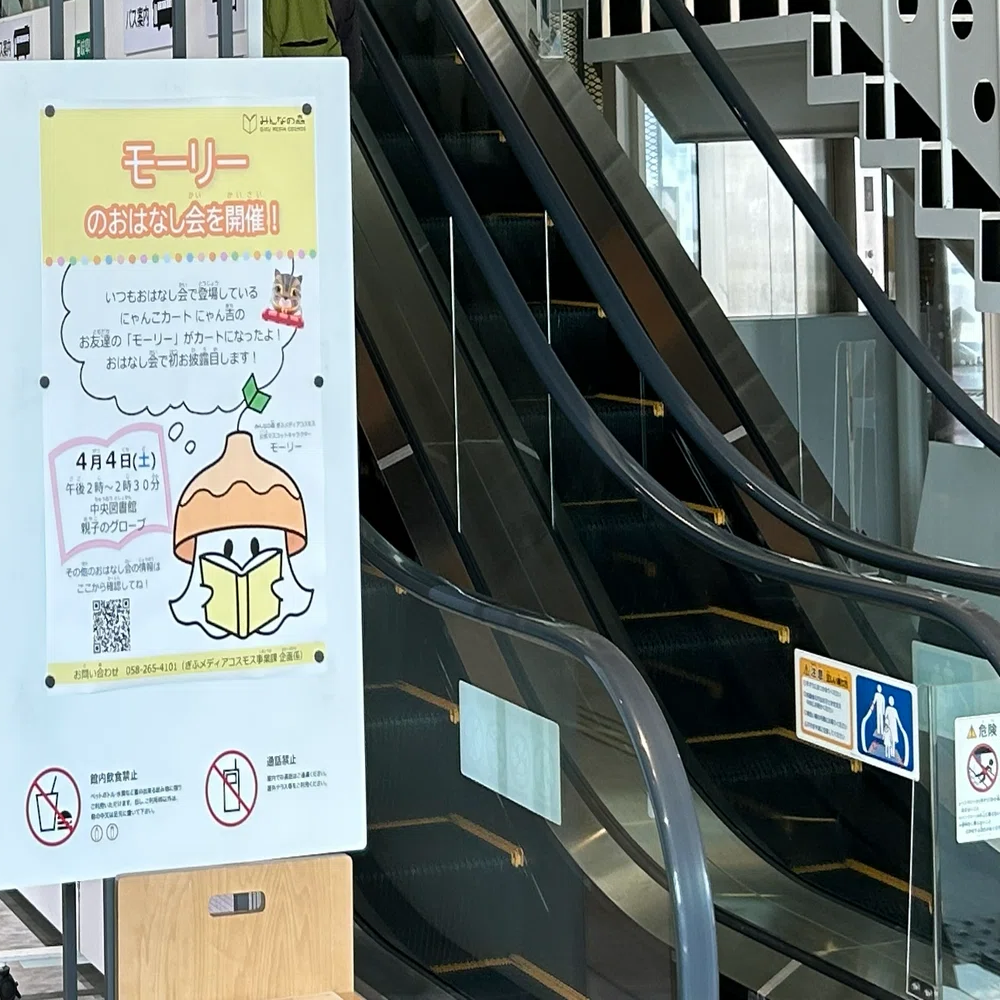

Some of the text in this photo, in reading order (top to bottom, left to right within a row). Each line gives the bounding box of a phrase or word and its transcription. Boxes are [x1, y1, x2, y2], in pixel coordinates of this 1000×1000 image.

[126, 7, 149, 29] バス案内
[121, 137, 250, 189] モーリー
[84, 199, 280, 238] のおはなし会を開催！
[105, 286, 258, 303] いつもおはなし会で登場している
[120, 308, 245, 325] にゃんこカート にゃん吉の
[106, 351, 257, 370] おはなし会で初お披露目します！
[270, 442, 302, 453] モーリー
[90, 501, 137, 515] 中央図書館
[77, 579, 148, 594] ここから確認してね！
[73, 667, 119, 680] お問い合わせ
[125, 662, 177, 675] 058-265-4101
[978, 723, 998, 738] 危険
[90, 769, 138, 785] 館内飲食禁止
